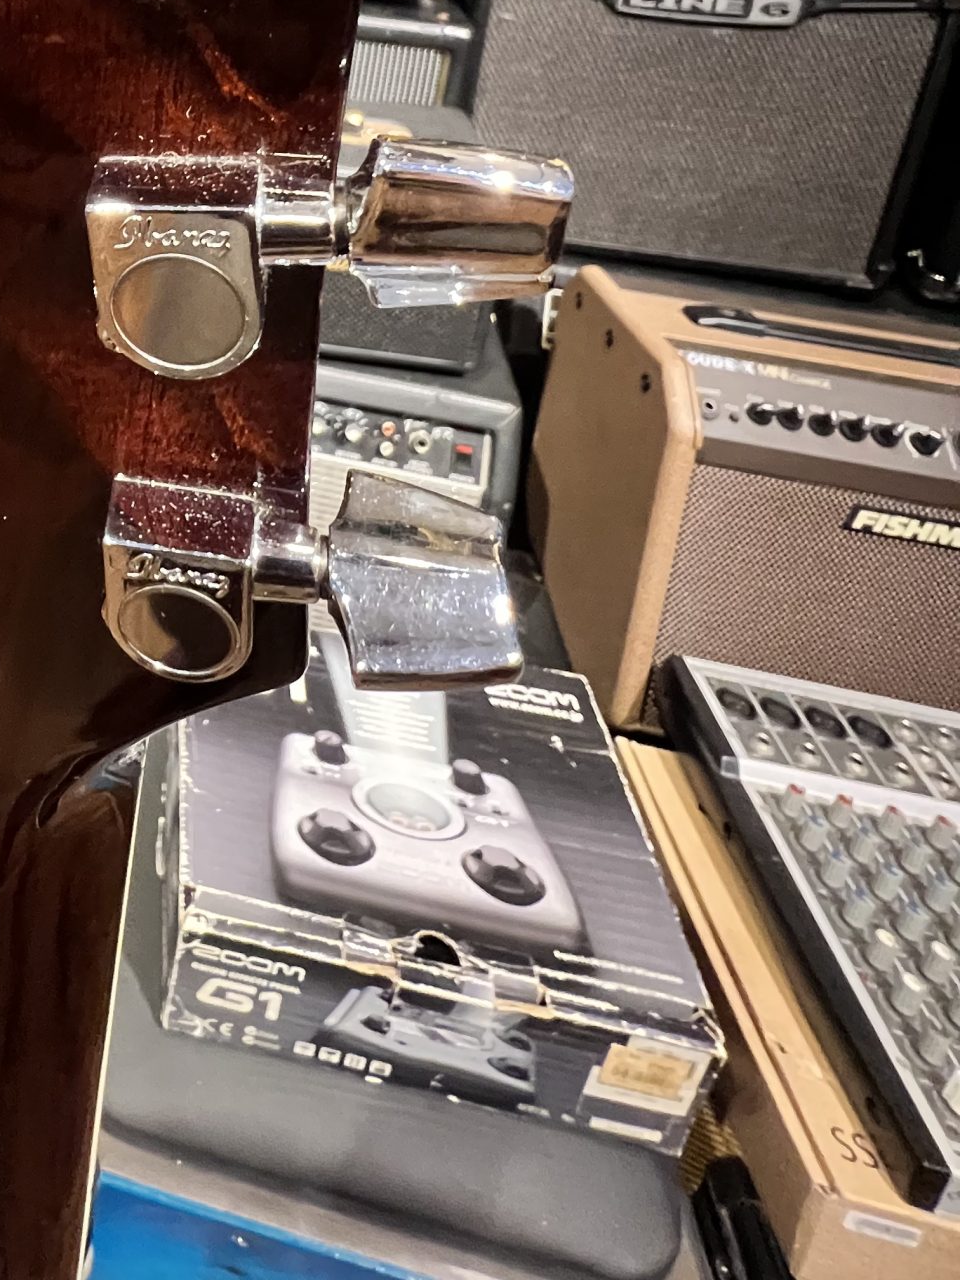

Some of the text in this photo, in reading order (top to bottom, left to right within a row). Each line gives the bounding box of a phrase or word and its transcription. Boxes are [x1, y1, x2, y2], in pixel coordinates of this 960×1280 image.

[113, 215, 231, 258] Ibanez
[126, 552, 230, 599] Ibanez
[192, 945, 307, 982] ZOOM
[196, 978, 283, 1021] G1
